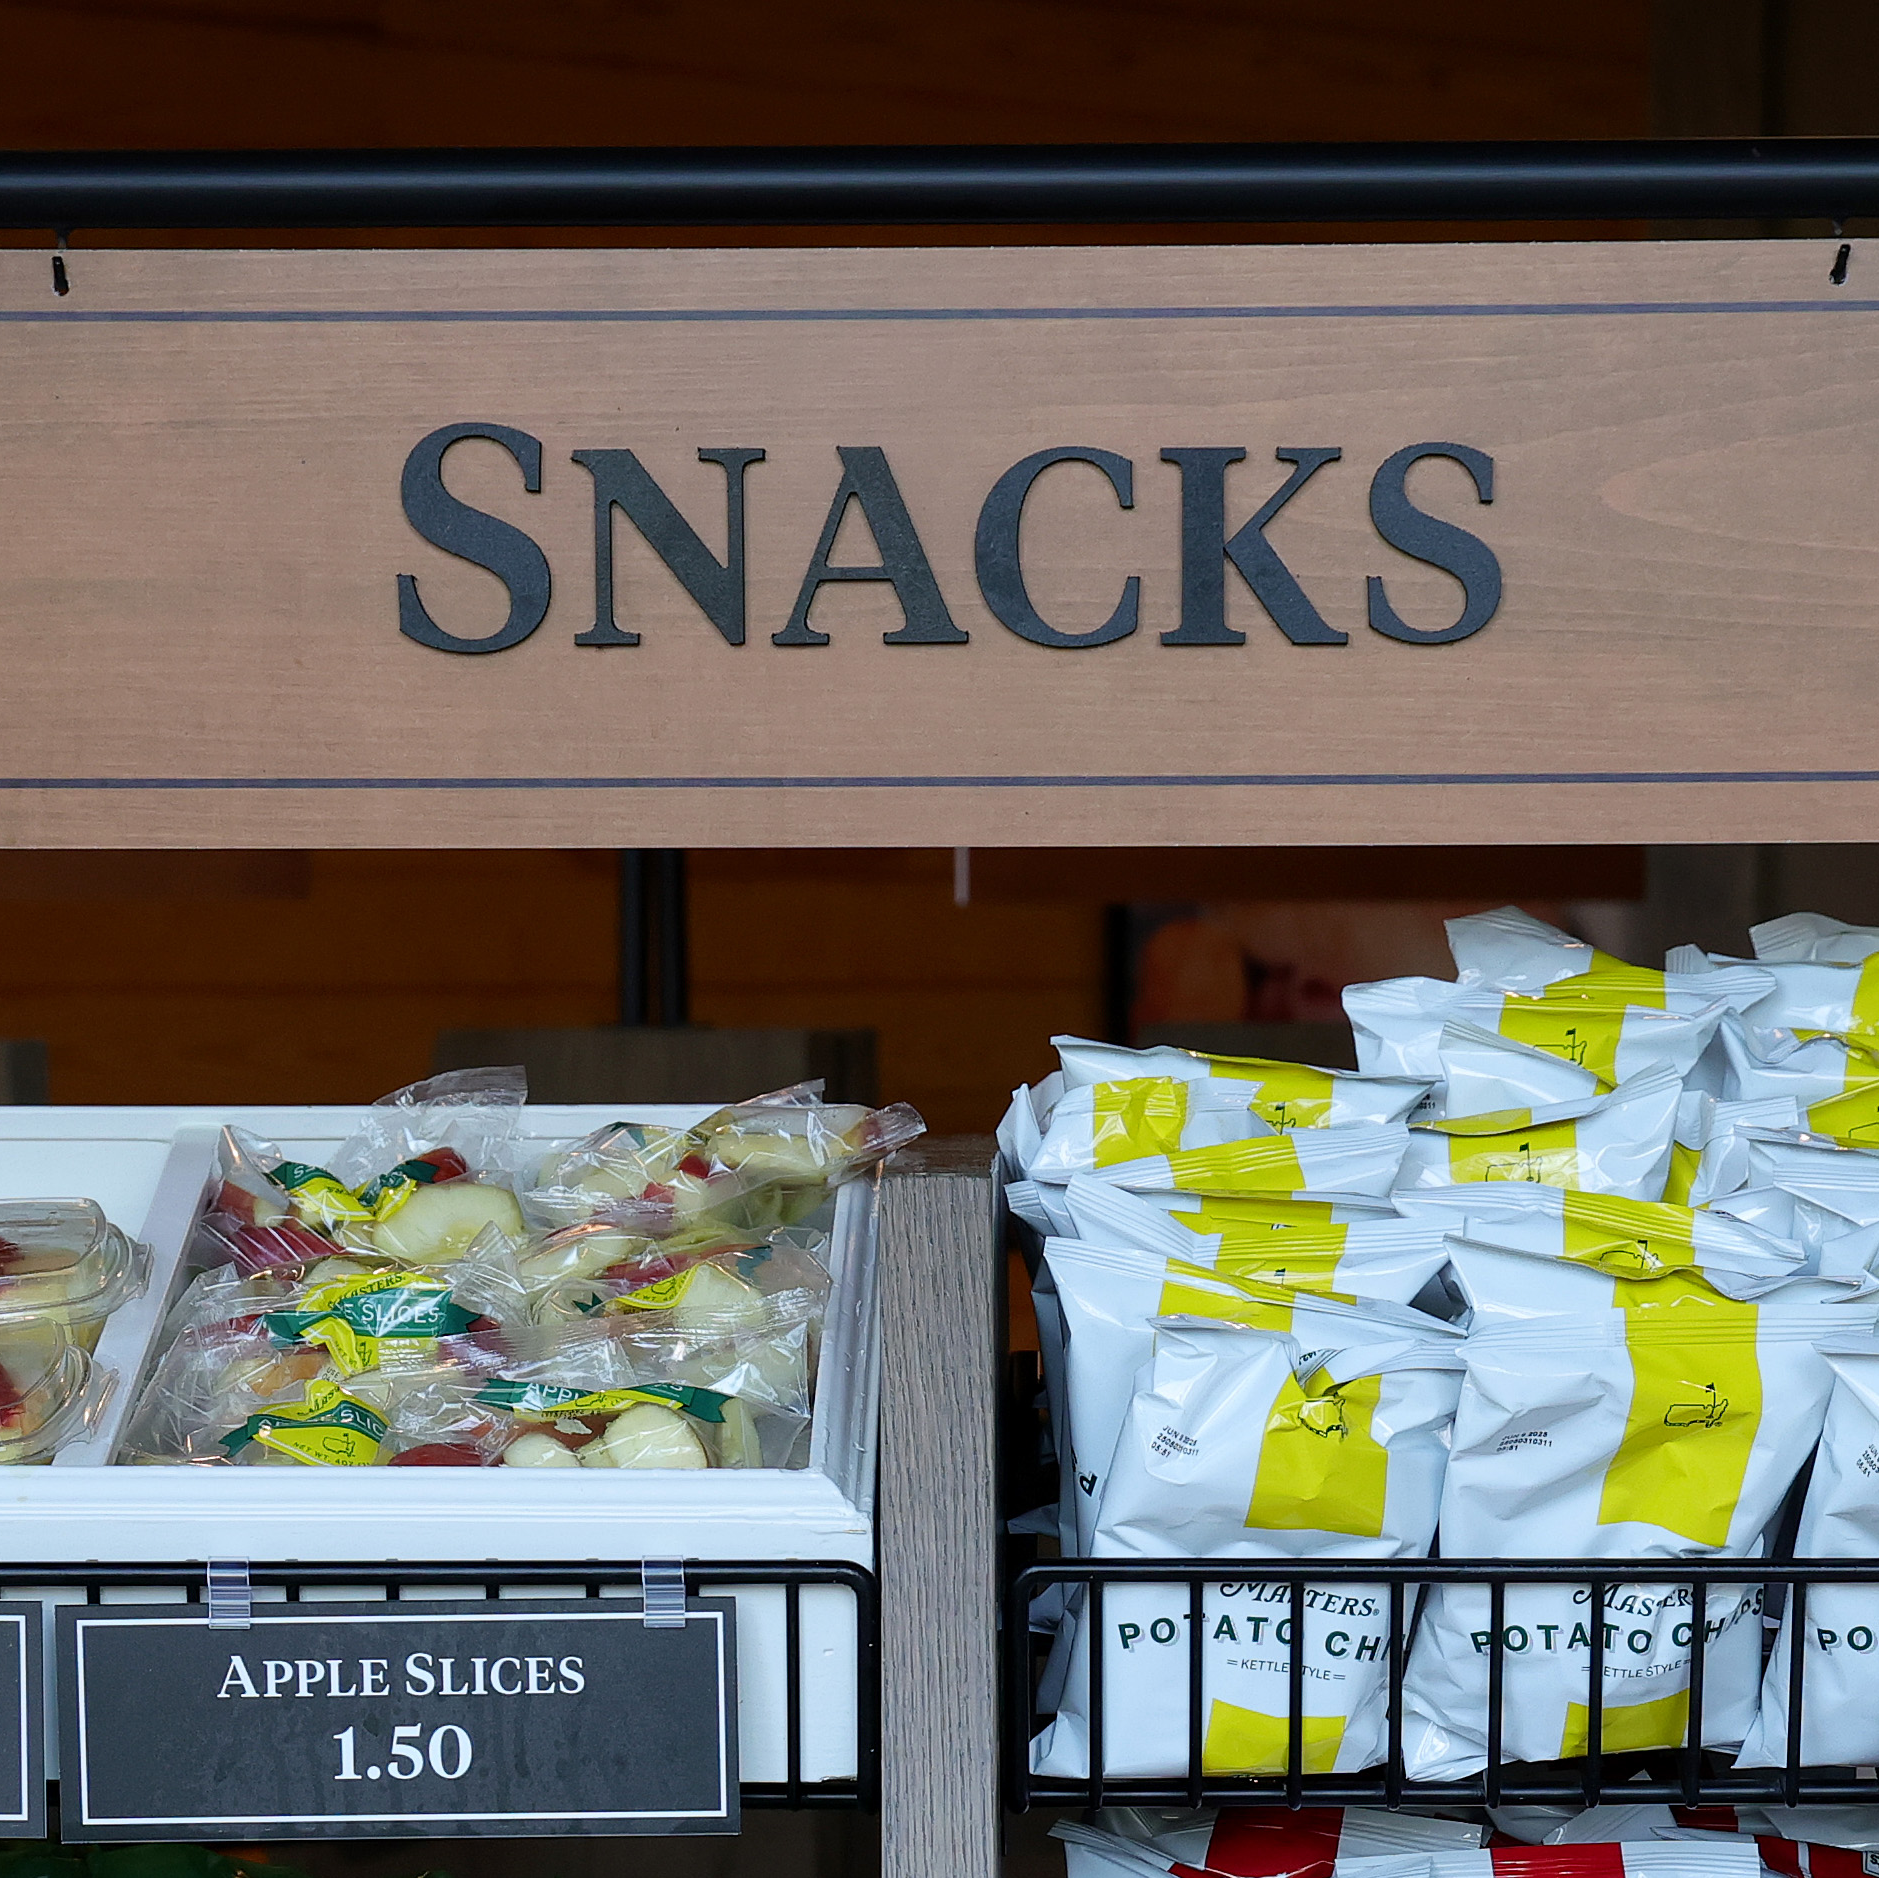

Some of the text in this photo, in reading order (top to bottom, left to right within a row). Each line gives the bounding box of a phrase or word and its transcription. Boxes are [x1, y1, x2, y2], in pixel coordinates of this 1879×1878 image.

[395, 421, 1504, 657] SNACKS
[361, 1303, 439, 1324] SLICES
[1220, 1583, 1375, 1618] MATERS
[1118, 1613, 1293, 1651] POATO
[217, 1653, 584, 1697] APPLE SLICES
[1603, 1664, 1644, 1680] ETTLE
[333, 1723, 472, 1779] 1.50
